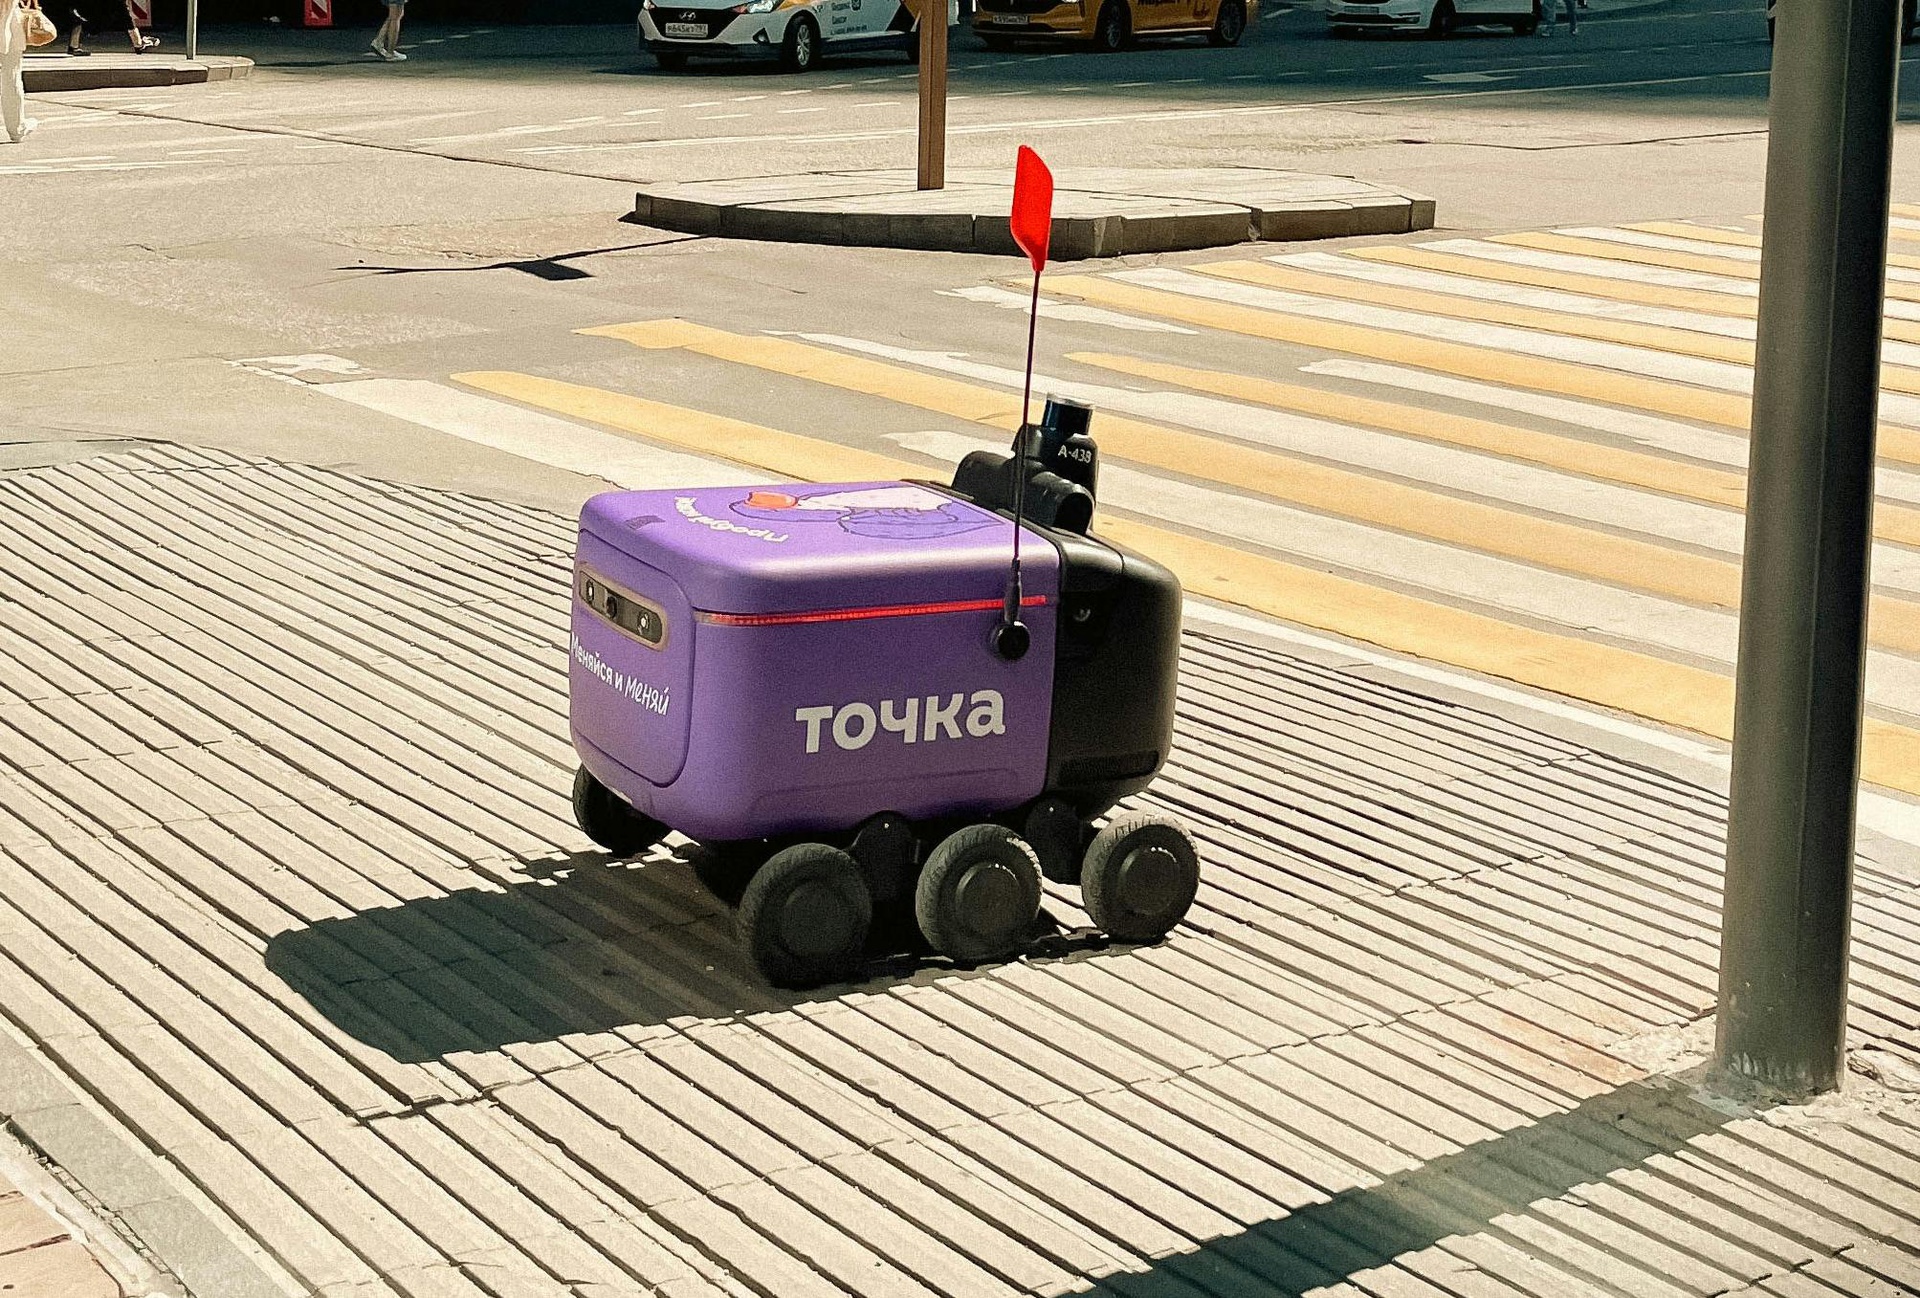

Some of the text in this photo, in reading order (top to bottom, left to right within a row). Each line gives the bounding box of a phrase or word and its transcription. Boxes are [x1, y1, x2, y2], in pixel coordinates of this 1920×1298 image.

[571, 631, 670, 715] Меняйся и Меняй
[795, 689, 1006, 754] точка
